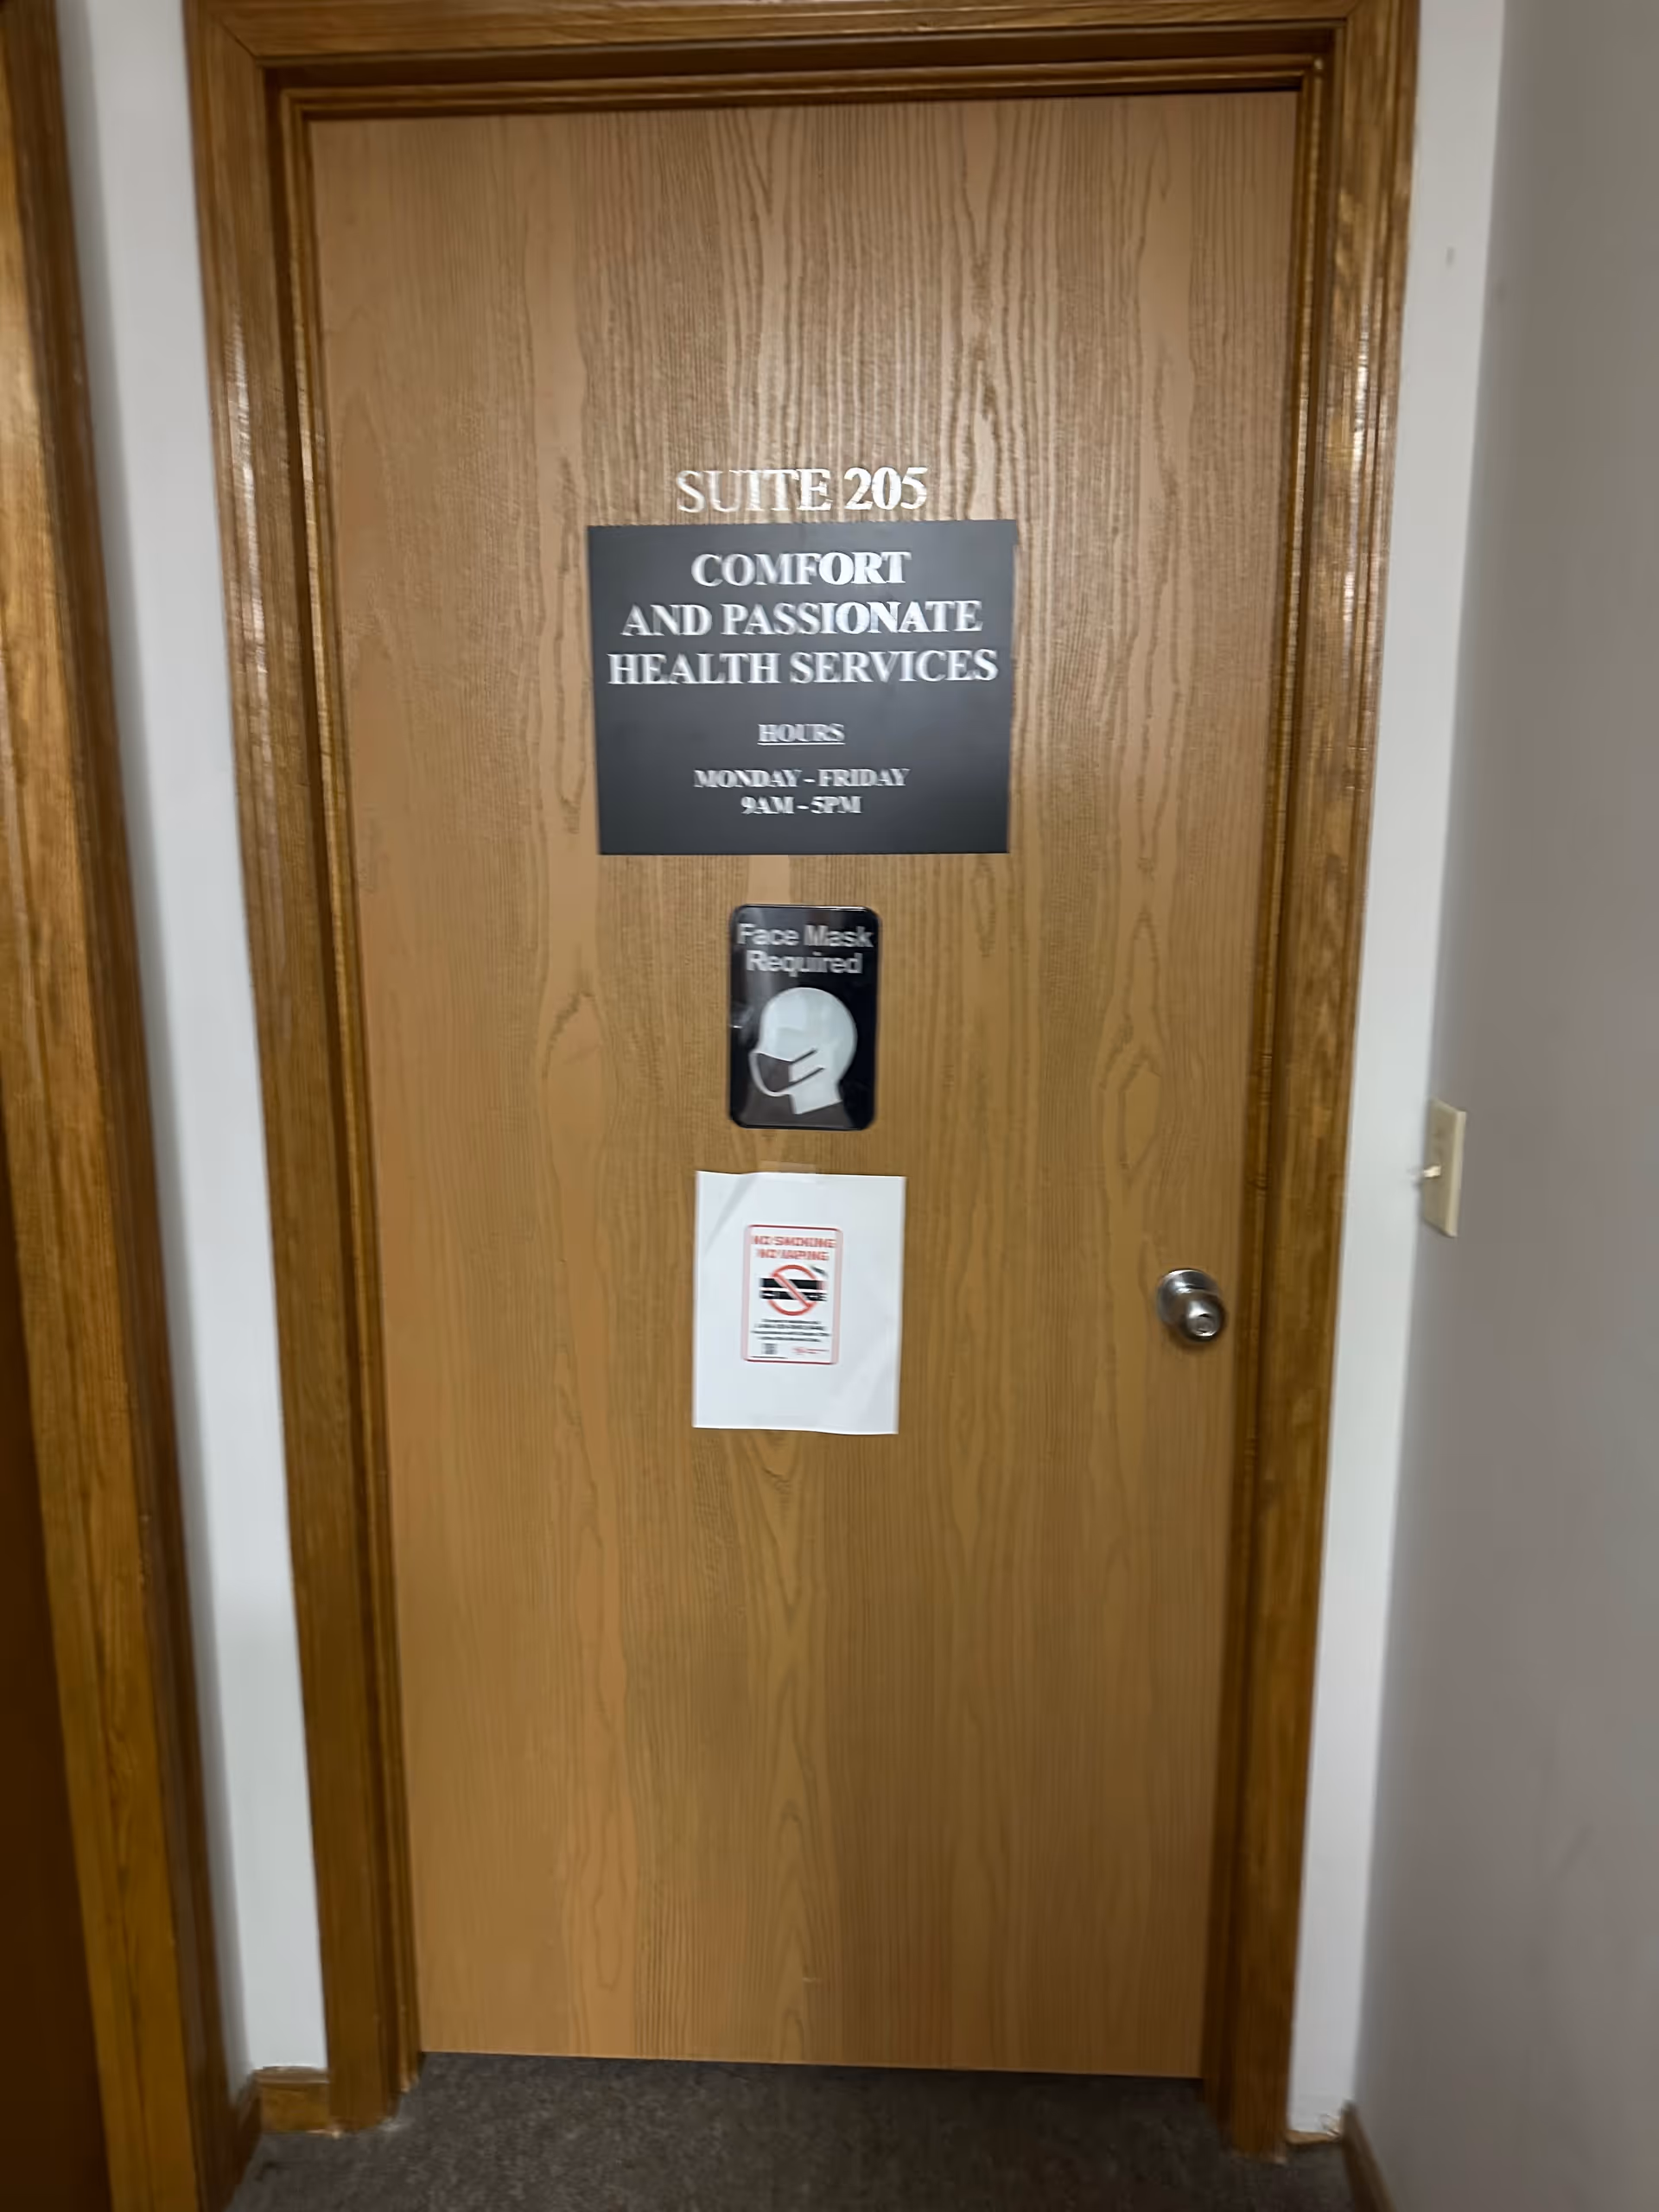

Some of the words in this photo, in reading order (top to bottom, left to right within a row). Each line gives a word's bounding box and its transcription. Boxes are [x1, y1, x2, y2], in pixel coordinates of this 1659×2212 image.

[676, 468, 832, 513] SUITE
[844, 467, 929, 512] 205
[691, 550, 912, 588] COMFORT
[620, 604, 713, 637] AND
[721, 600, 983, 636] PASSIONATE
[607, 652, 781, 685] HEALTH
[790, 649, 998, 684] SERVICES
[758, 723, 845, 745] HOURS
[694, 769, 802, 788] MONDAY
[818, 768, 910, 787] FRIDAY
[741, 797, 795, 815] 9AM
[810, 796, 861, 814] 5PM
[737, 923, 799, 946] Face
[804, 925, 874, 948] Mask
[747, 950, 863, 976] Required
